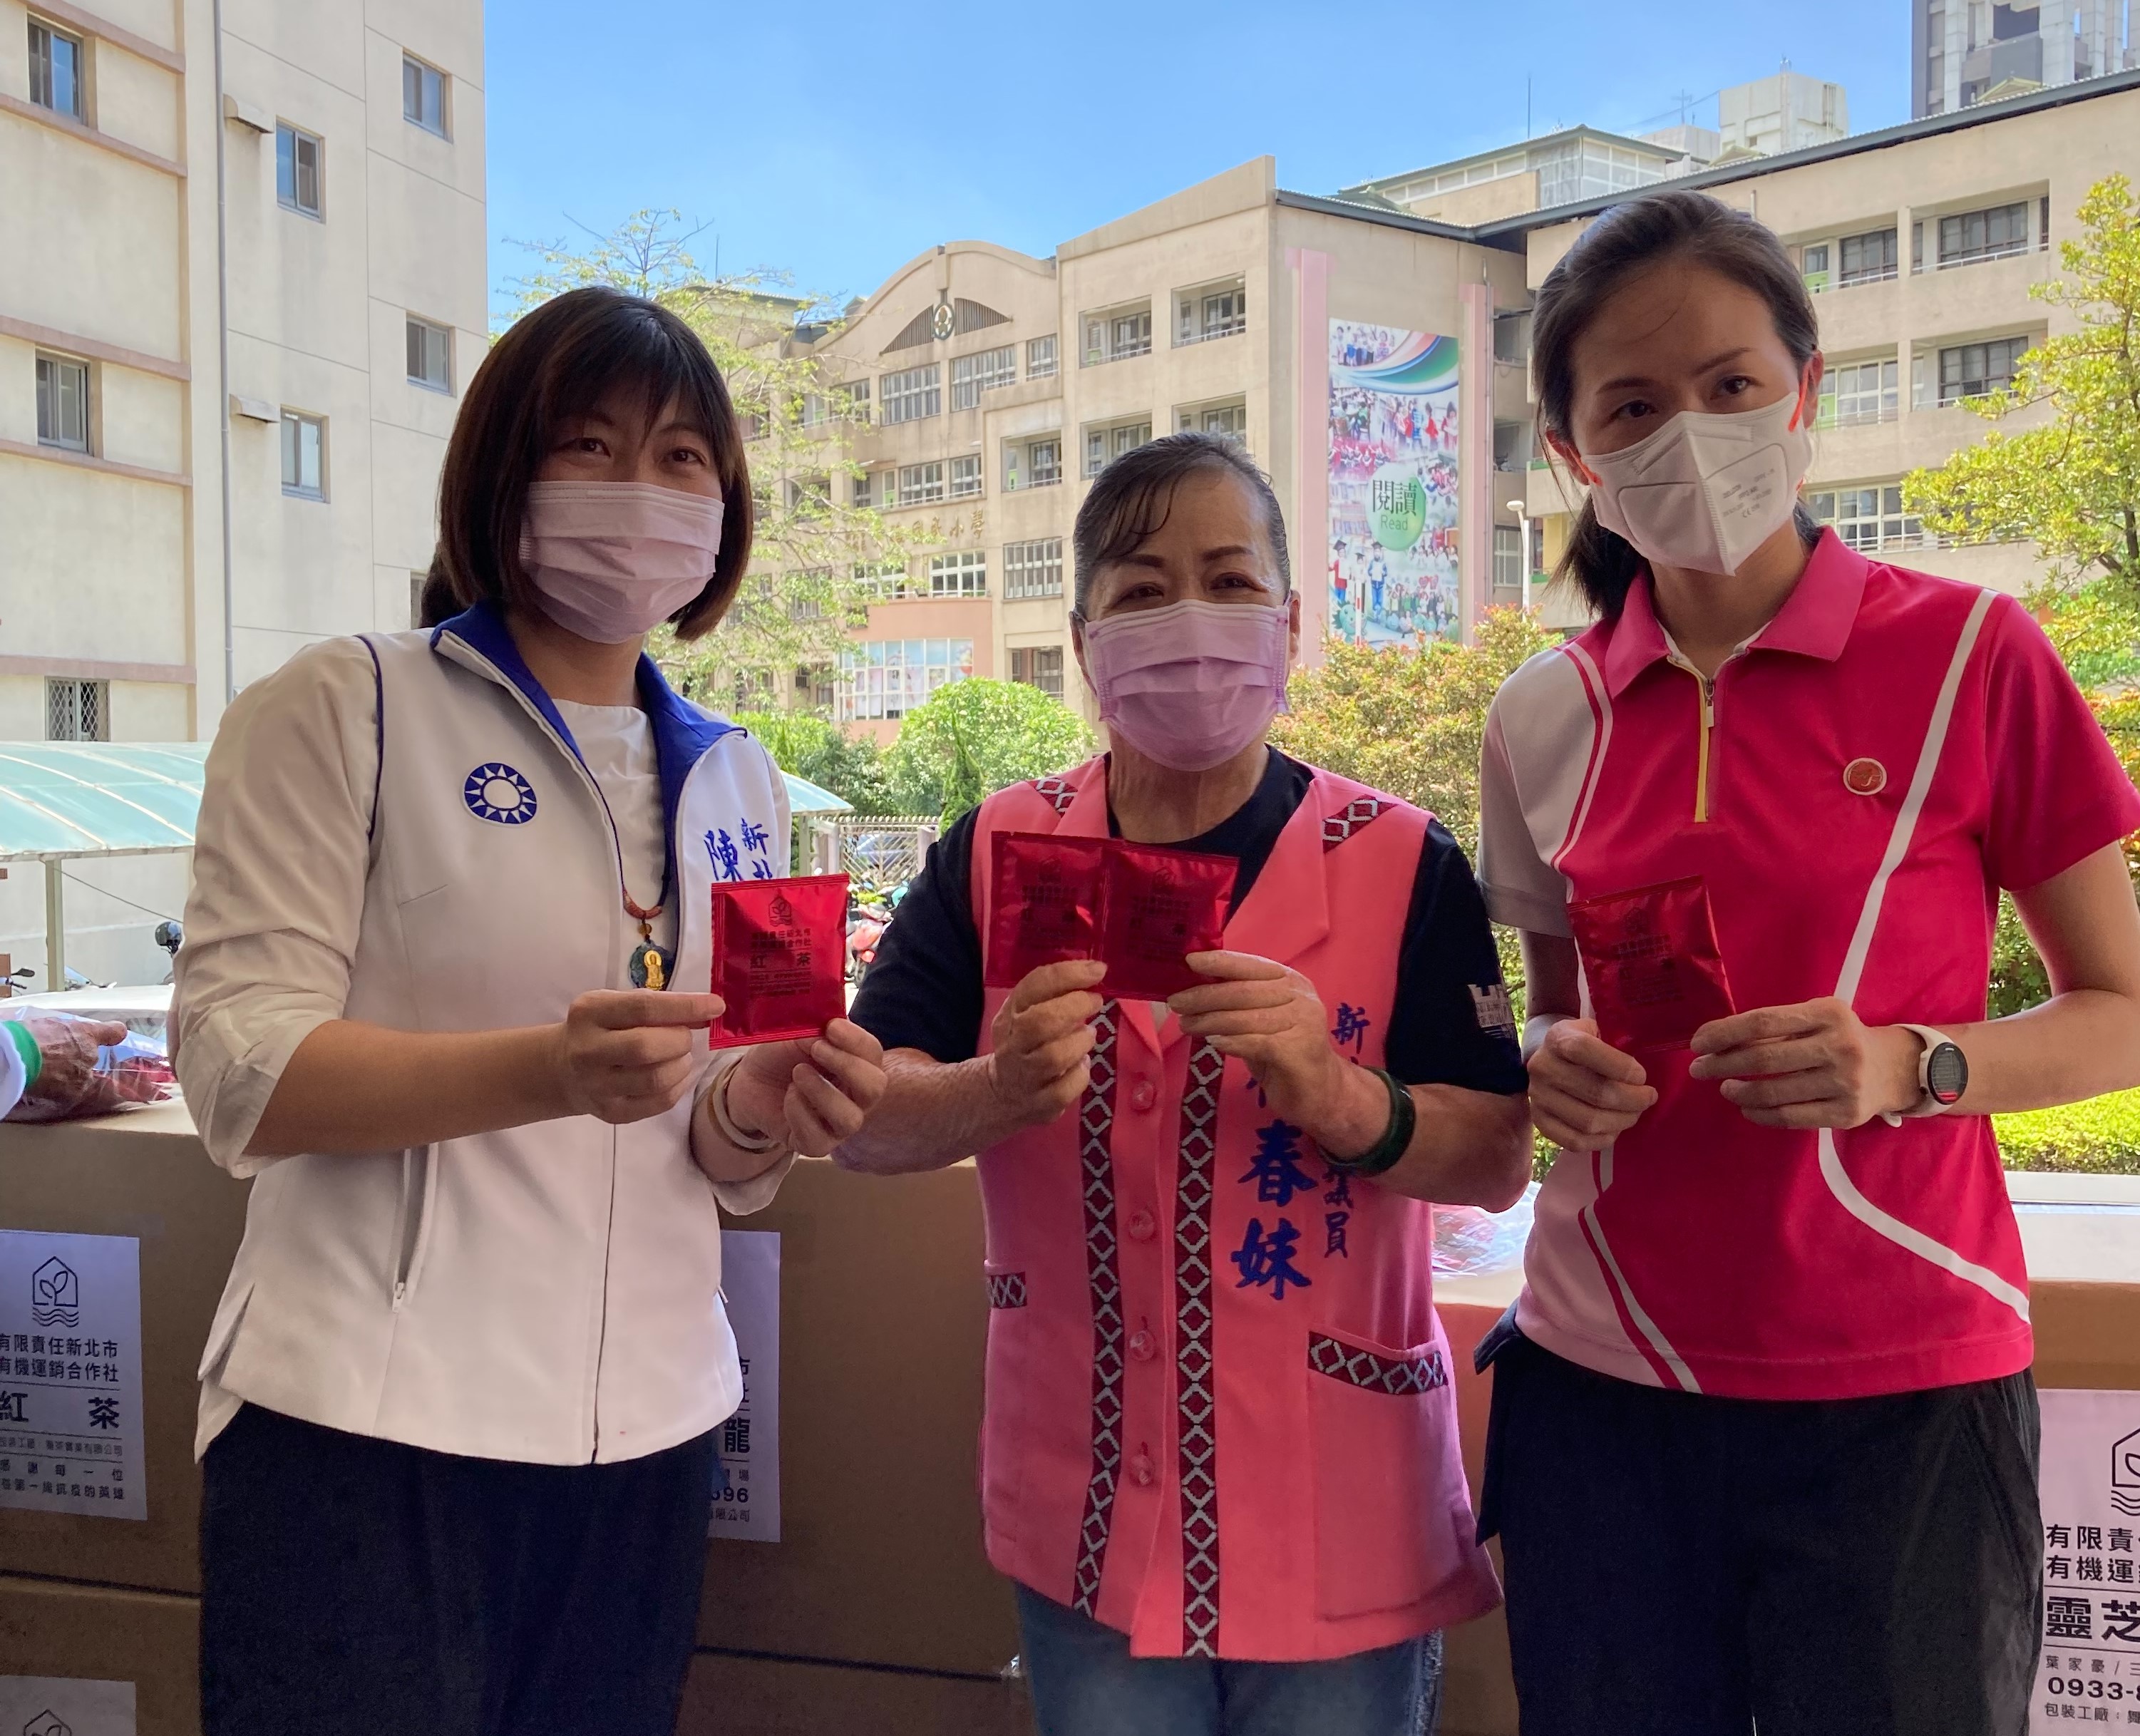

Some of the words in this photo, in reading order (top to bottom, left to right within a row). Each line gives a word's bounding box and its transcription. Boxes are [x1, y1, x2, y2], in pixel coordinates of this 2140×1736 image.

[1372, 478, 1417, 517] 閱讀
[1381, 514, 1409, 532] Read
[1231, 1077, 1319, 1301] 春妹
[0, 1333, 118, 1358] 有限責任新北市
[0, 1357, 119, 1382] 有機運銷合作社
[710, 1507, 750, 1522] 限公司
[2046, 1524, 2140, 1553] 有限責
[2046, 1555, 2140, 1583] 有機運
[2046, 1596, 2140, 1640] 靈芝
[2047, 1677, 2140, 1702] 0933-
